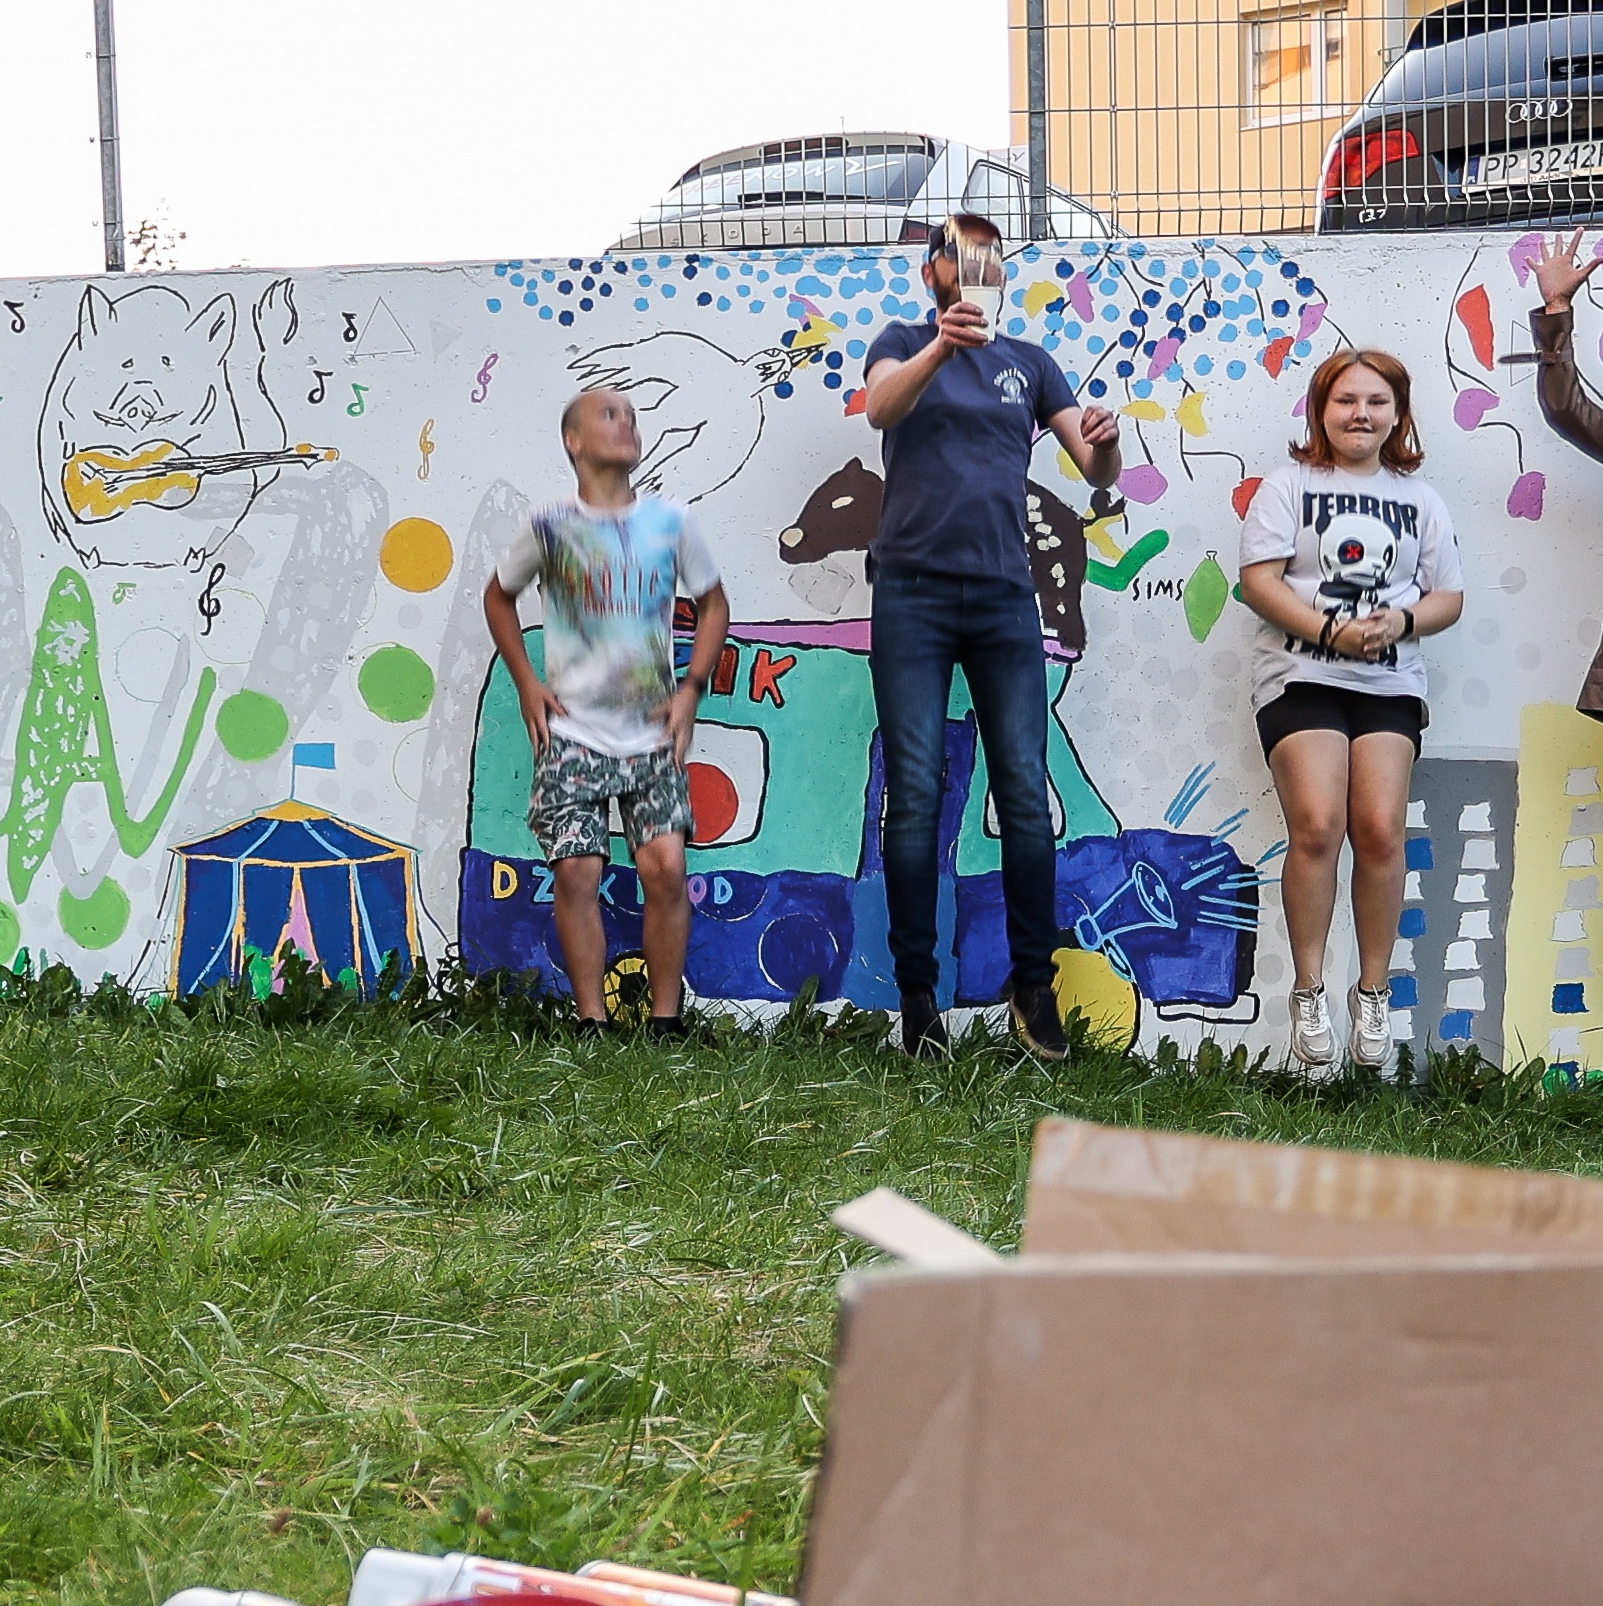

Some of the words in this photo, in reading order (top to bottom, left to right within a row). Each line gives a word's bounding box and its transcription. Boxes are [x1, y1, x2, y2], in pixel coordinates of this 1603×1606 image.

[1484, 154, 1518, 183] PP
[1302, 491, 1418, 541] TERROR
[1132, 577, 1184, 601] SIMS
